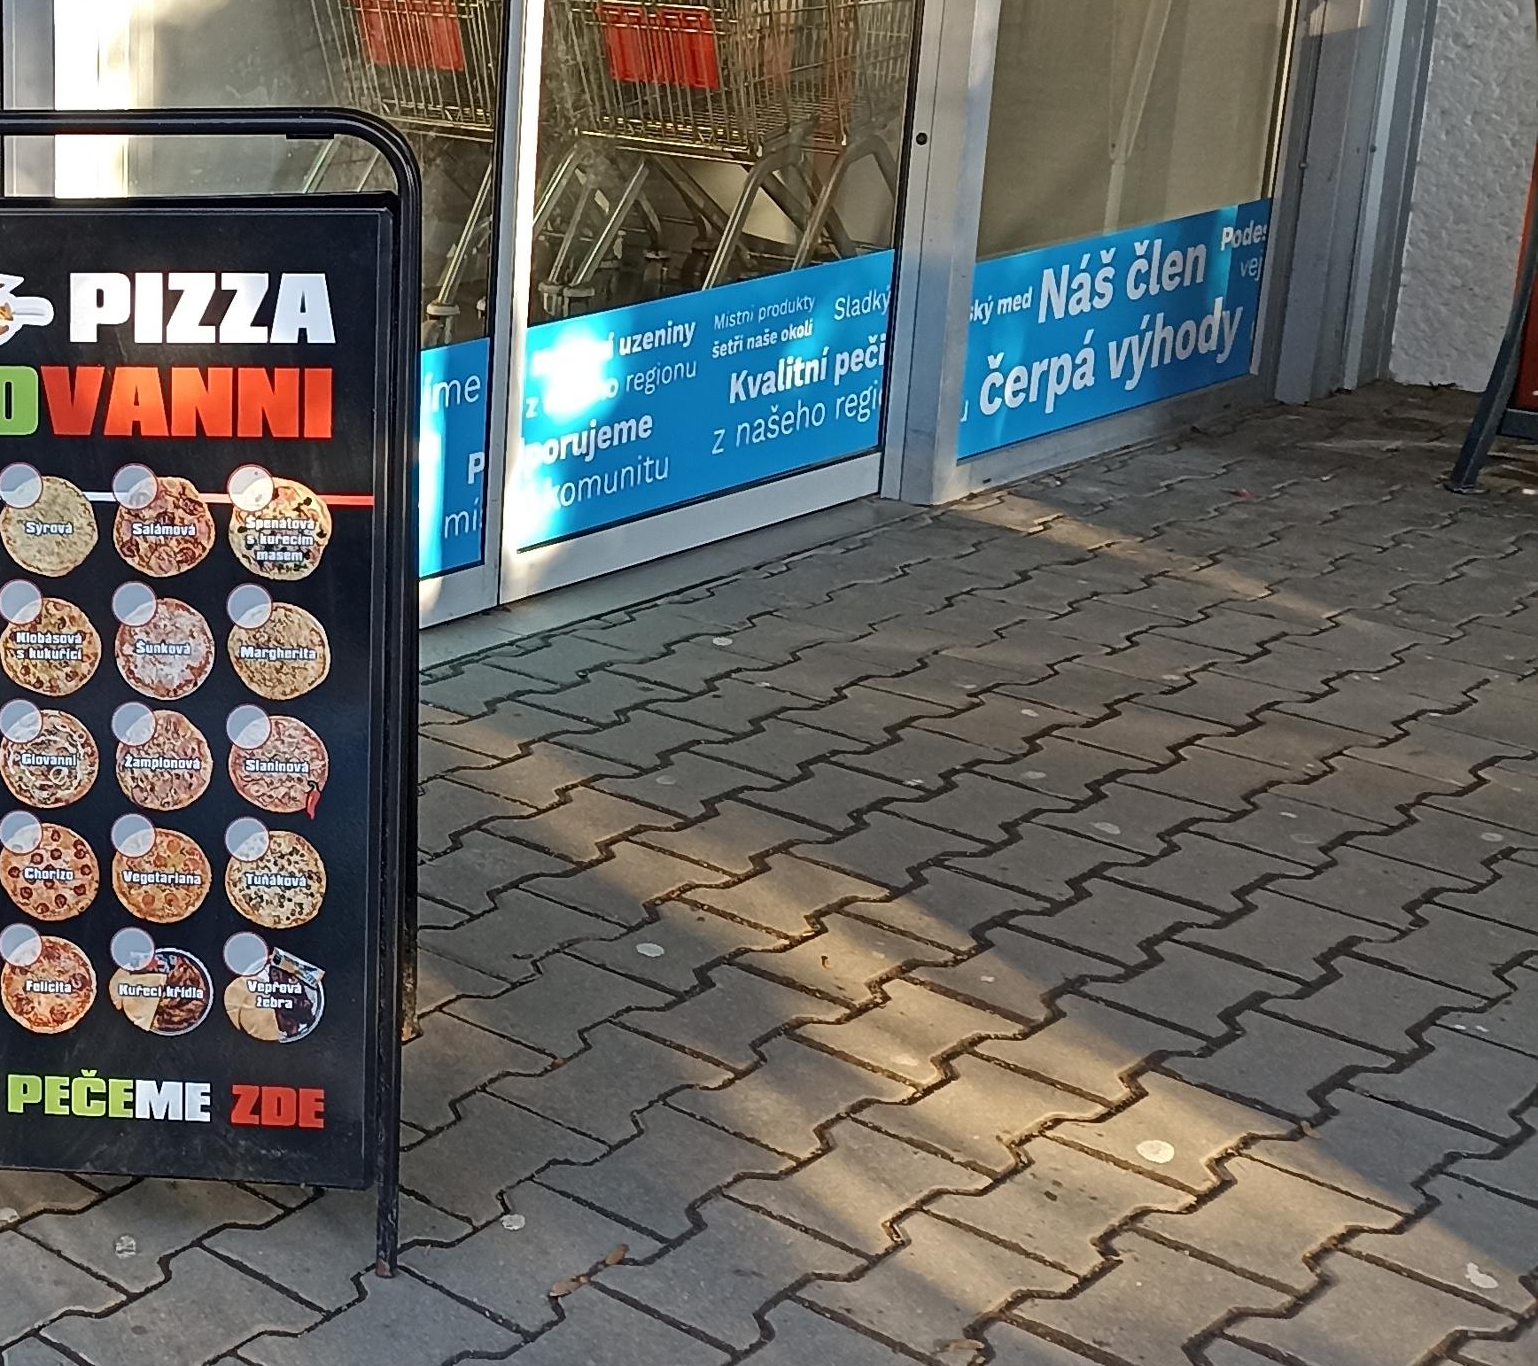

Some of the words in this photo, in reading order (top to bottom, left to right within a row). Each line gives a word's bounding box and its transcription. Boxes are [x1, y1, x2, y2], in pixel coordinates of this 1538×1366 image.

[1038, 247, 1117, 323] Náš
[1126, 238, 1206, 301] člen
[69, 272, 337, 344] PIZZA
[997, 286, 1033, 315] med
[714, 304, 754, 330] Místní
[758, 295, 815, 323] produkty
[619, 320, 696, 356] uzeniny
[712, 334, 744, 358] šetří
[746, 328, 778, 350] naše
[781, 318, 814, 342] okolí
[979, 328, 1095, 414] čerpá
[1108, 296, 1244, 392] výhody
[729, 346, 830, 404] Kvalitní
[526, 397, 539, 419] z
[626, 360, 698, 395] regionu
[711, 428, 726, 455] z
[735, 399, 826, 447] našeho
[547, 455, 670, 507] komunitu
[25, 521, 73, 536] Sýrová
[132, 521, 196, 536] Salámová
[245, 515, 315, 531] Špenátová
[246, 535, 255, 545] s
[256, 551, 303, 561] masem
[16, 631, 83, 645] Klobásová
[16, 649, 25, 660] s
[136, 638, 191, 655] Šunková
[240, 646, 316, 661] Margherita
[22, 753, 77, 766] Giovanni
[125, 754, 200, 771] Žampionová
[245, 759, 309, 773] Slaninová
[24, 867, 74, 880] Chorizo
[122, 870, 202, 886] Vegetariana
[245, 872, 307, 886] Tuňáková
[26, 980, 72, 993] Felicita
[119, 983, 162, 997] Kuřecí
[166, 983, 204, 999] křídla
[248, 980, 302, 995] Vepřová
[255, 995, 293, 1010] žebra
[7, 1068, 211, 1123] PEČEME
[230, 1083, 325, 1129] ZDE
